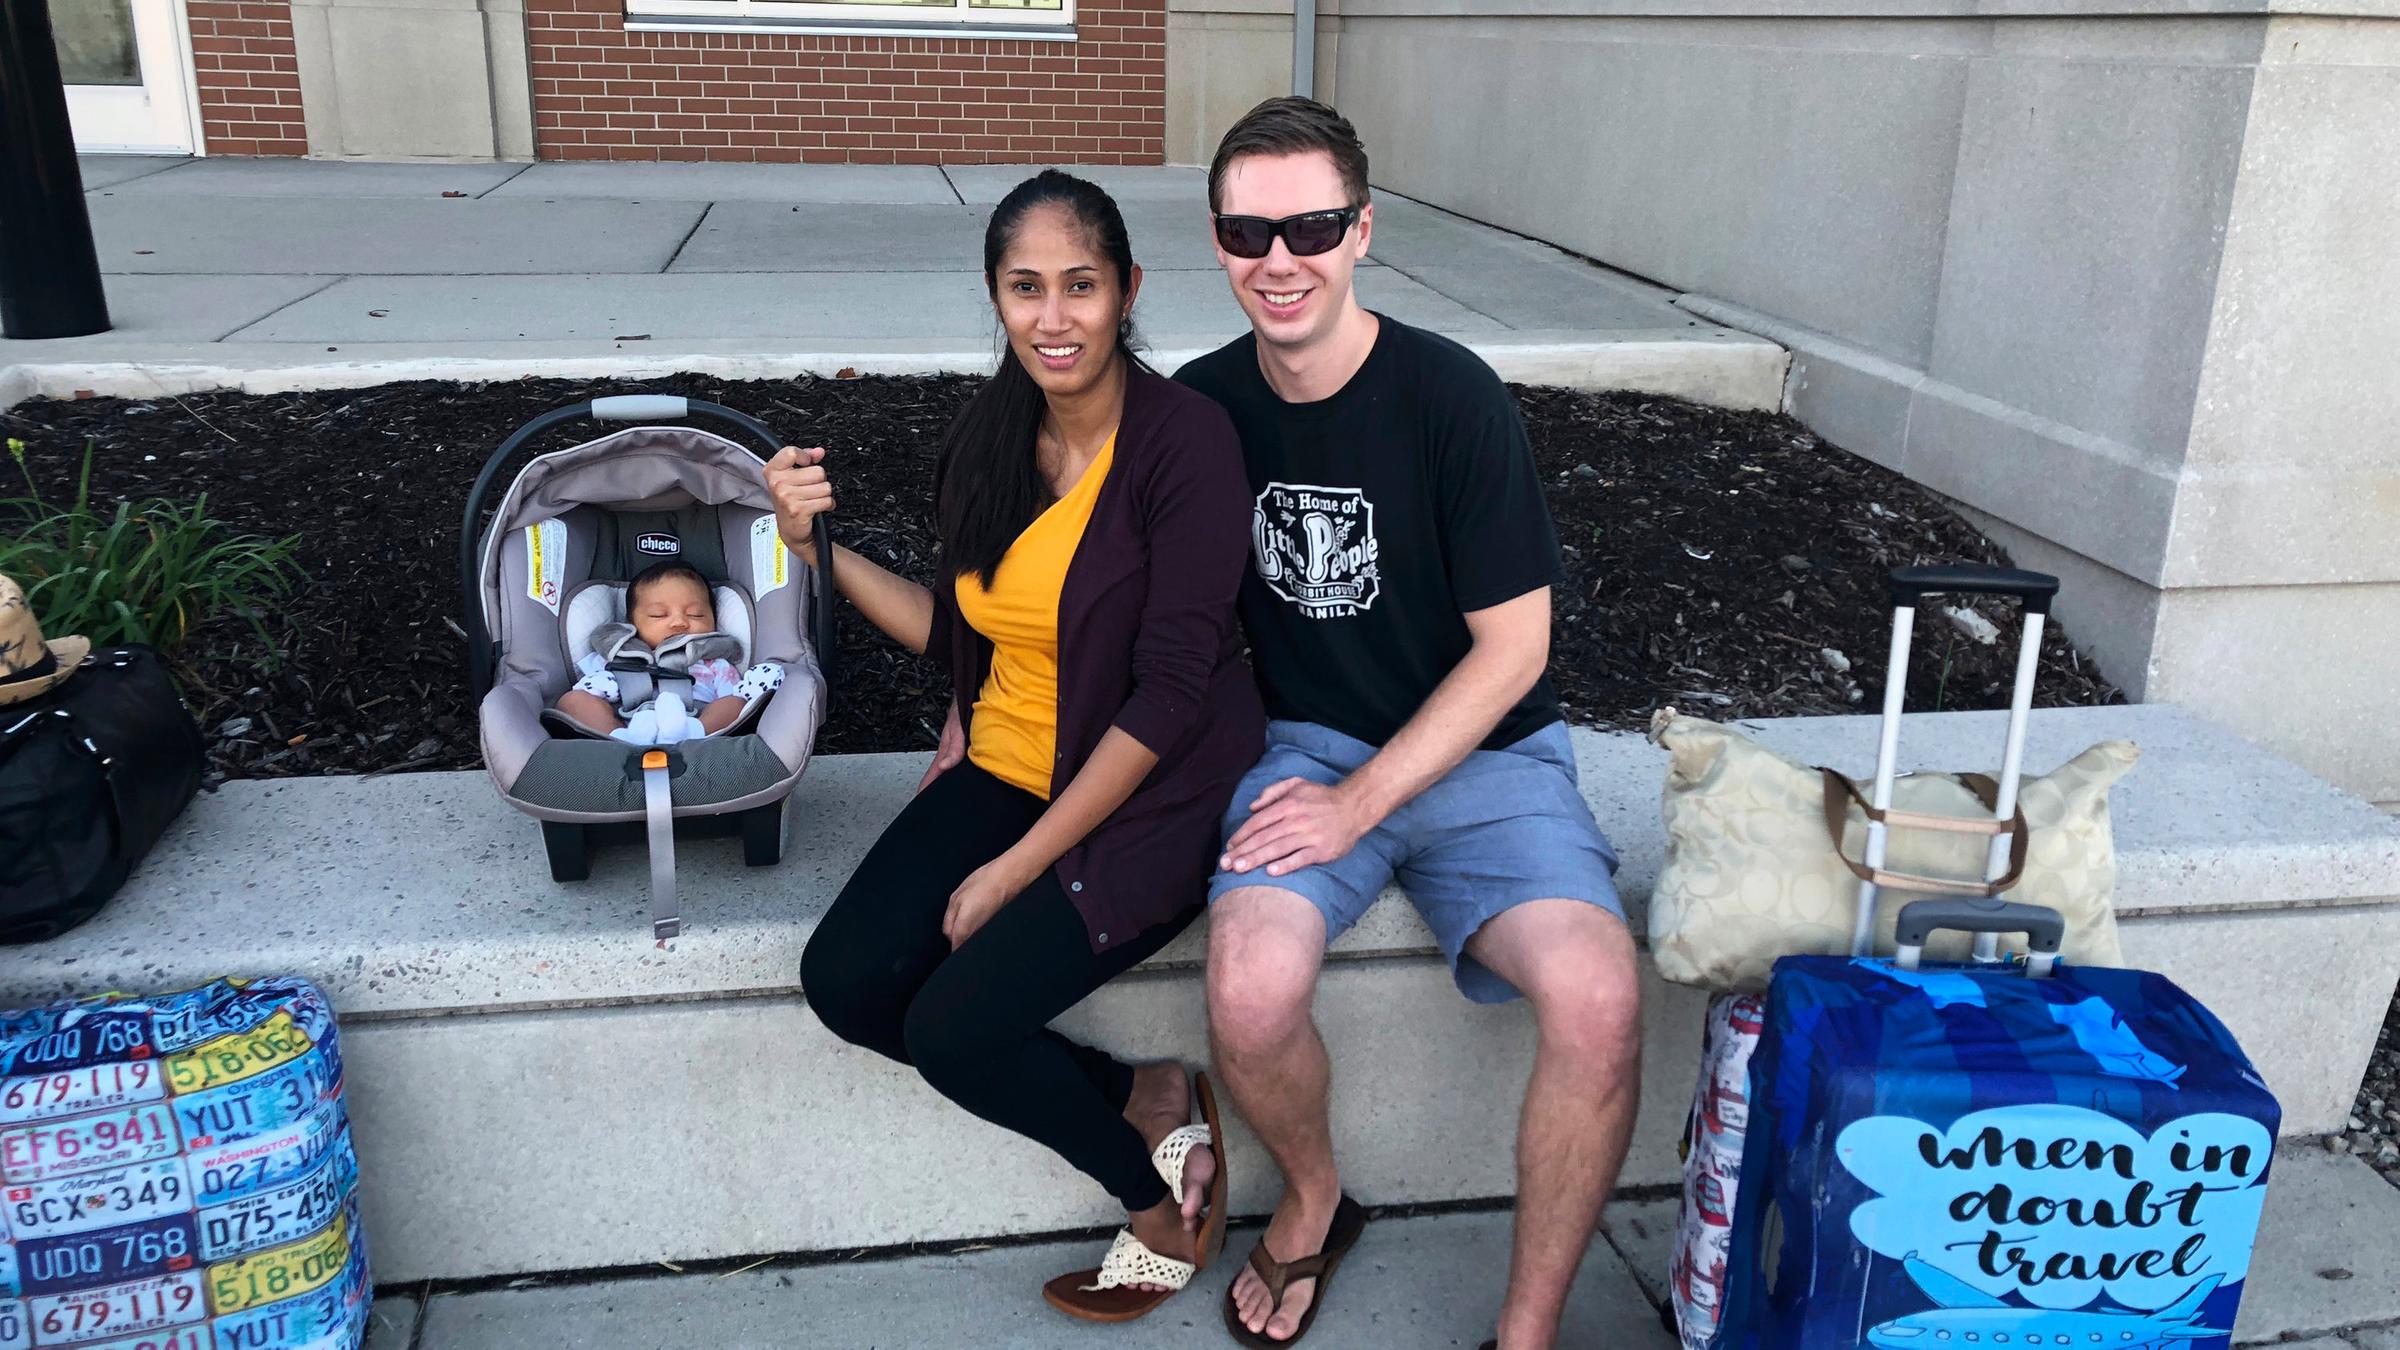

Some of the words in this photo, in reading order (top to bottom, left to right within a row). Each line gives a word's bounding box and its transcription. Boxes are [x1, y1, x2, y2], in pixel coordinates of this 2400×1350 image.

[1273, 491, 1294, 509] The
[1299, 493, 1338, 512] Home
[1342, 496, 1359, 514] of
[641, 536, 677, 551] chicco
[1252, 507, 1305, 581] Little
[1302, 512, 1378, 584] People
[1327, 585, 1356, 597] HOUSE
[227, 1067, 293, 1095] Oregon
[184, 1095, 252, 1138] YUT
[48, 1149, 132, 1172] MISSOURI
[203, 1135, 299, 1168] WASHINGTON
[1918, 1127, 2137, 1179] when
[2170, 1130, 2251, 1177] in
[57, 1171, 127, 1192] Maryland
[16, 1193, 86, 1227] GCX
[110, 1176, 180, 1211] 349
[1949, 1181, 2239, 1228] doubt
[112, 1227, 188, 1268] 768
[1945, 1230, 2212, 1286] travel
[223, 1312, 290, 1350] YUT
